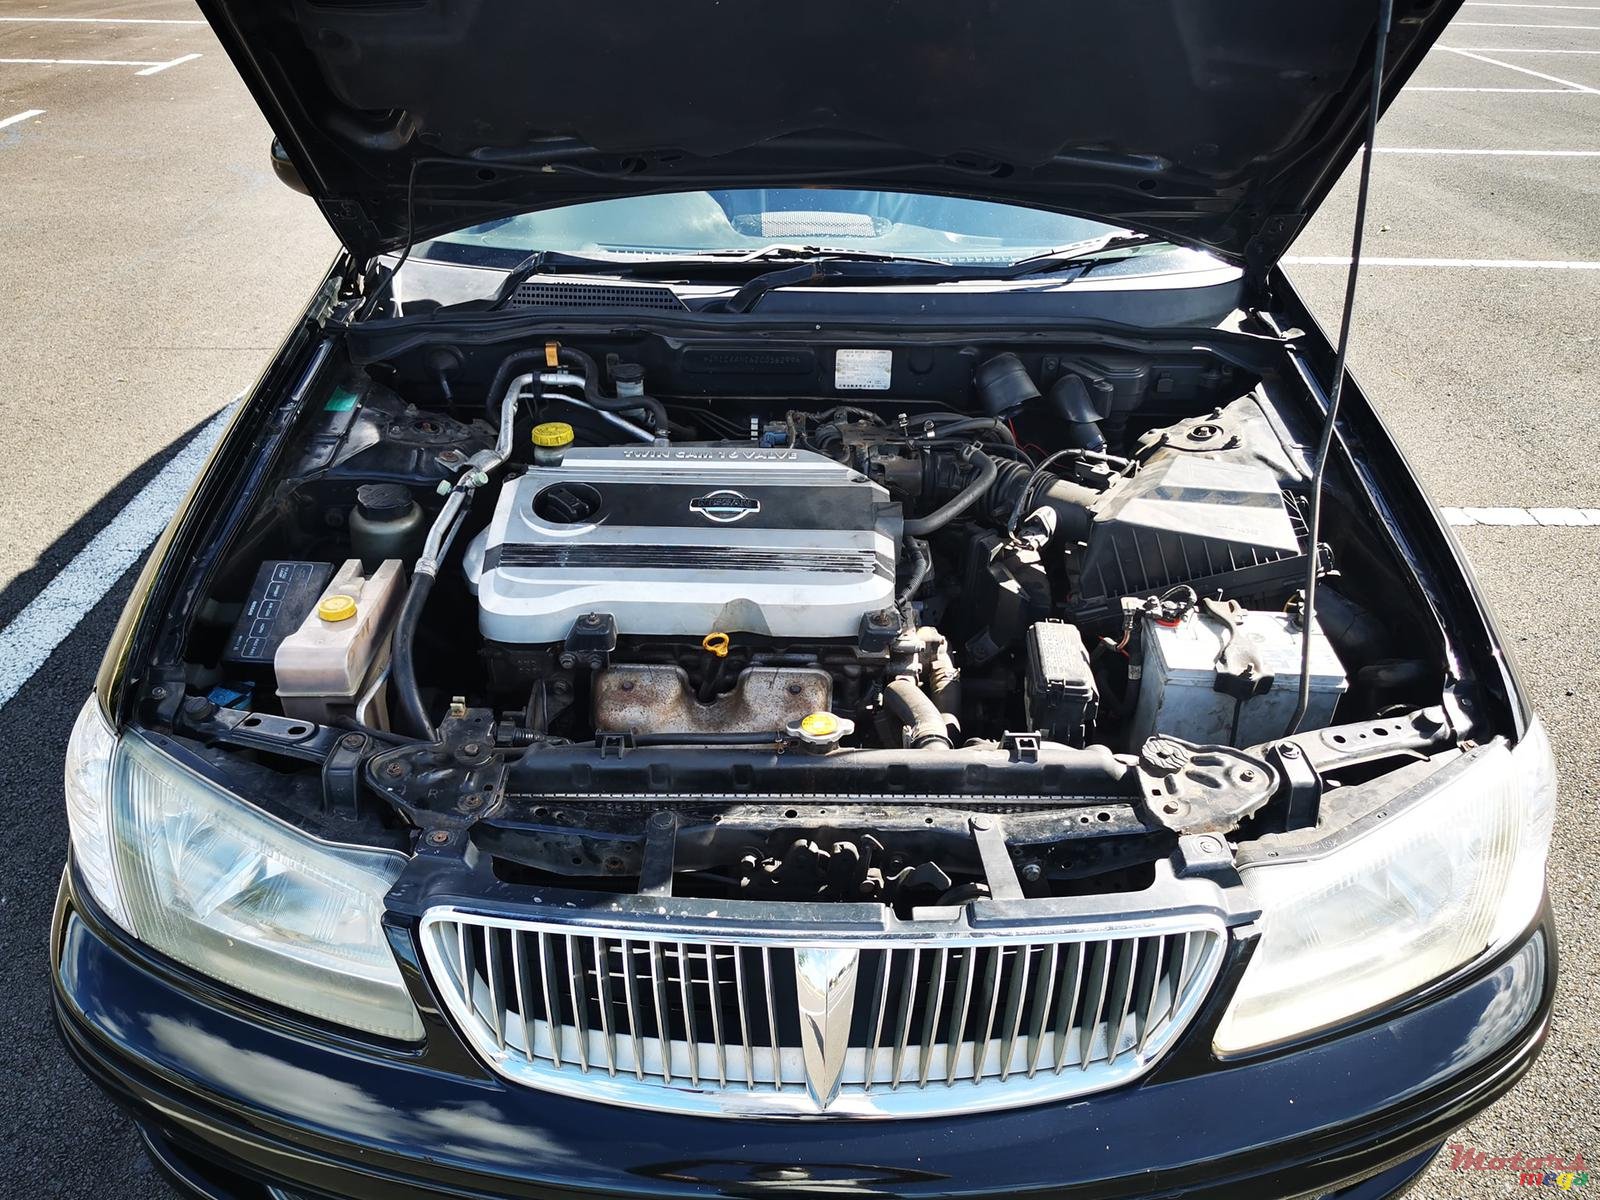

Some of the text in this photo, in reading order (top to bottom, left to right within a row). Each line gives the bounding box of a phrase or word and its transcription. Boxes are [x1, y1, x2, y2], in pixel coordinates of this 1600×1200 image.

[623, 450, 671, 459] TWIN
[675, 451, 713, 460] CAM
[742, 451, 798, 460] VALVE
